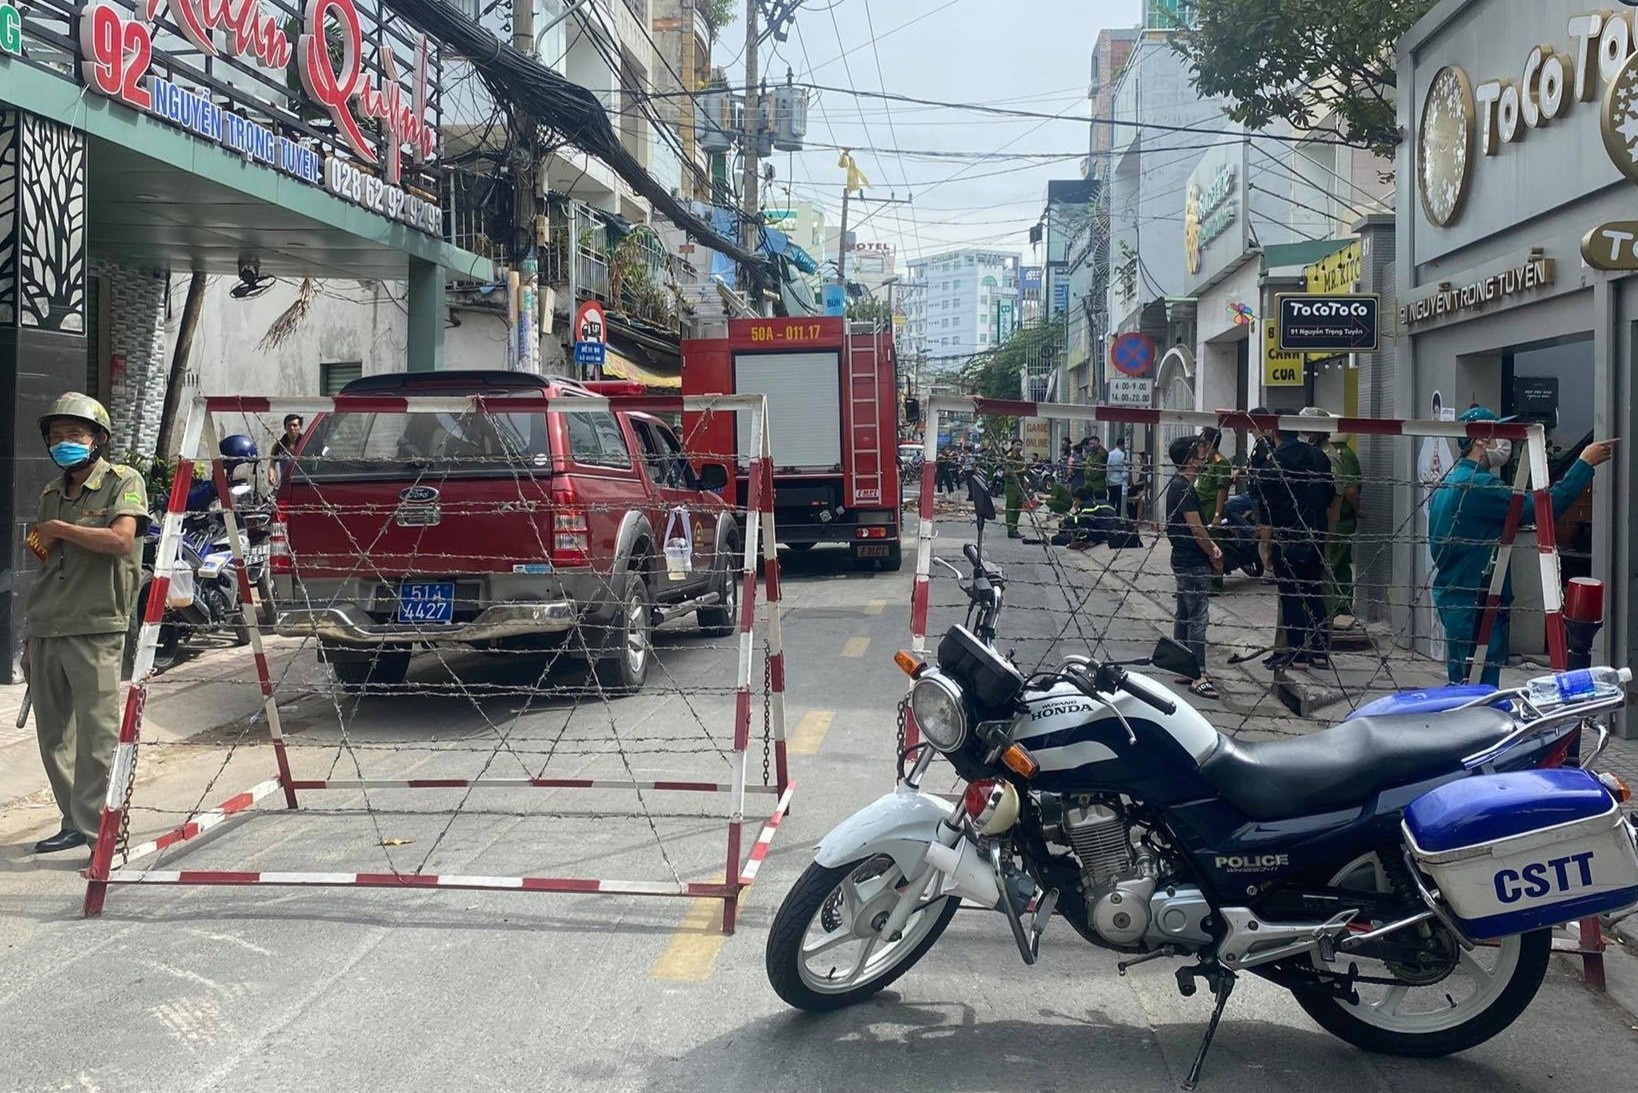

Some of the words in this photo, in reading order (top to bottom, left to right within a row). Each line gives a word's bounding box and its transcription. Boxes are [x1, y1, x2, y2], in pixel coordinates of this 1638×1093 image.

[92, 3, 151, 111] 92
[154, 75, 223, 143] NGUYỄN
[227, 110, 275, 165] TRỌNG
[330, 156, 362, 202] 028
[364, 173, 385, 212] 62
[387, 186, 406, 219] 92
[409, 195, 427, 229] 92
[427, 203, 443, 238] 93
[1290, 302, 1368, 316] ToCoToCo
[751, 326, 774, 341] 50A
[785, 325, 820, 340] 011.17
[1272, 368, 1296, 381] CUA
[404, 602, 447, 620] 4427
[1031, 704, 1094, 721] HONDA
[1215, 854, 1289, 869] POLICE
[1494, 851, 1595, 904] CSTT
